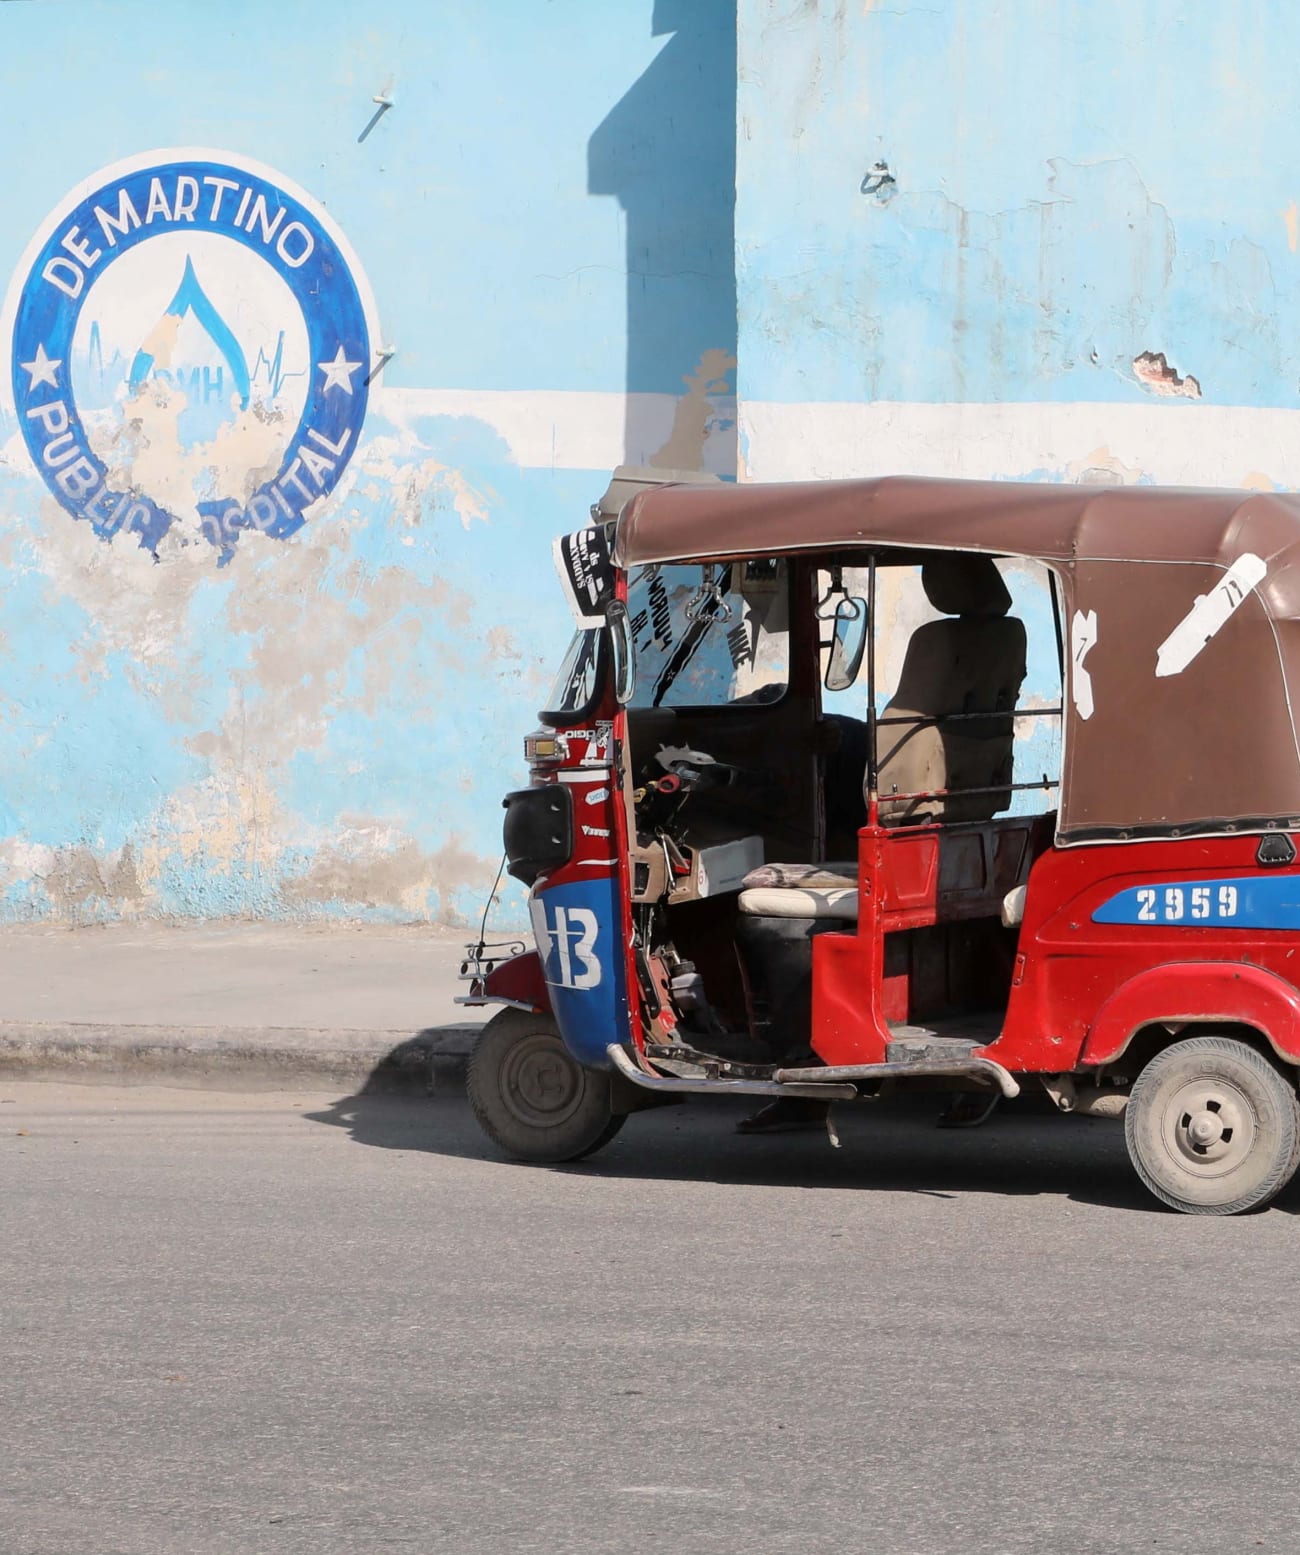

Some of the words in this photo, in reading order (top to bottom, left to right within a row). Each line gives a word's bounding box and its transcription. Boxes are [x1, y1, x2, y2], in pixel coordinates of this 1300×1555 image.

[42, 226, 102, 299] DE
[94, 176, 315, 268] MARTINO
[1137, 886, 1237, 921] 2959
